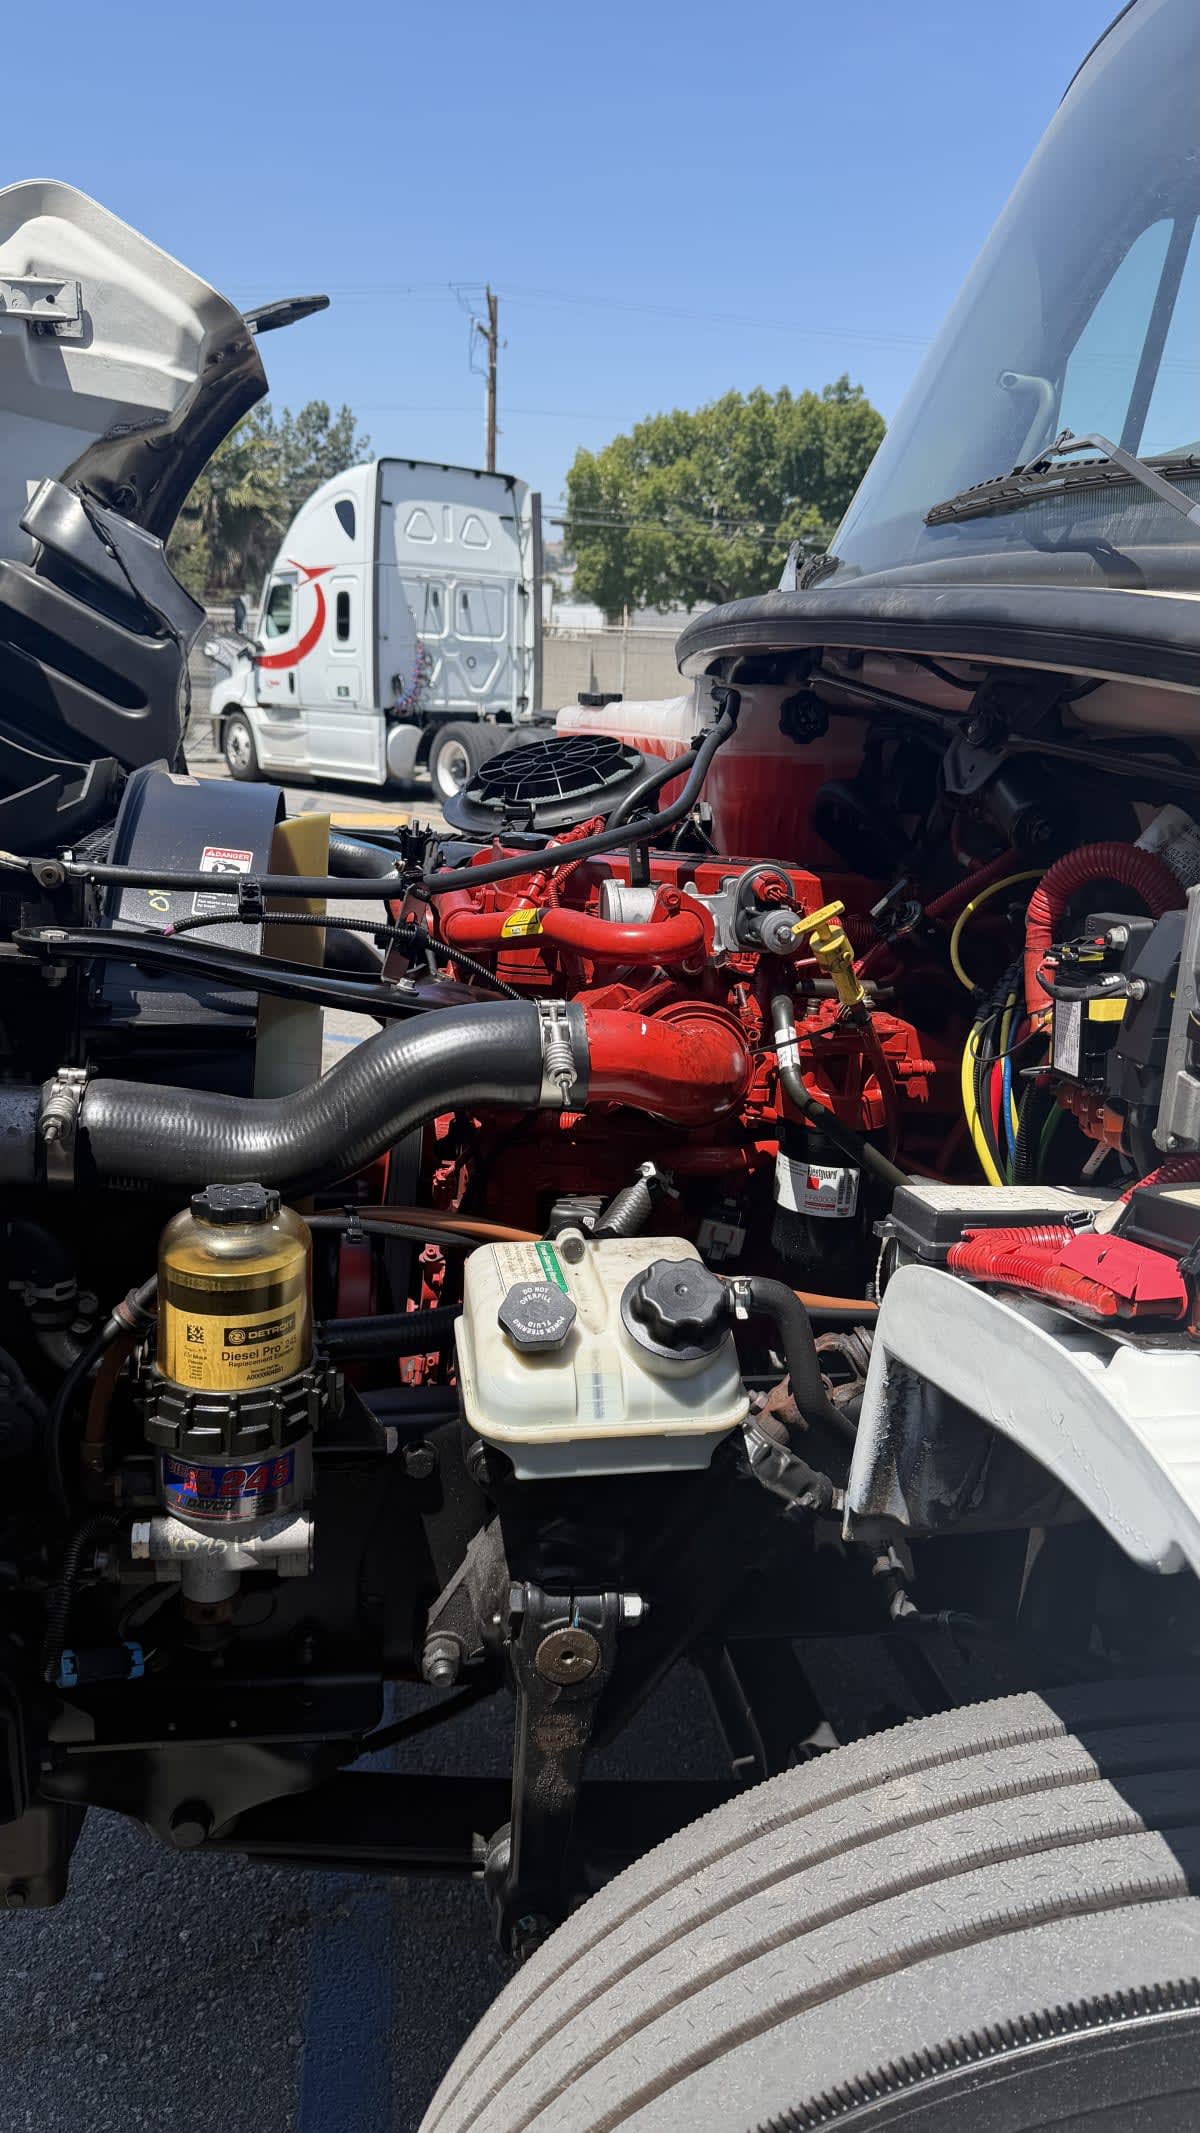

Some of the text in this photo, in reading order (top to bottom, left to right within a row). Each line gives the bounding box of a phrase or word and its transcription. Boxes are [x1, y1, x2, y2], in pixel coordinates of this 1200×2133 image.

[215, 851, 250, 861] DANGER
[521, 1286, 549, 1295] DO NOT
[519, 1293, 552, 1305] OVERFILL
[248, 1318, 295, 1340] DETROIT
[512, 1318, 545, 1336] STEERING
[527, 1319, 552, 1329] FLUID
[221, 1348, 259, 1362] Diesel
[263, 1344, 281, 1356] Pro
